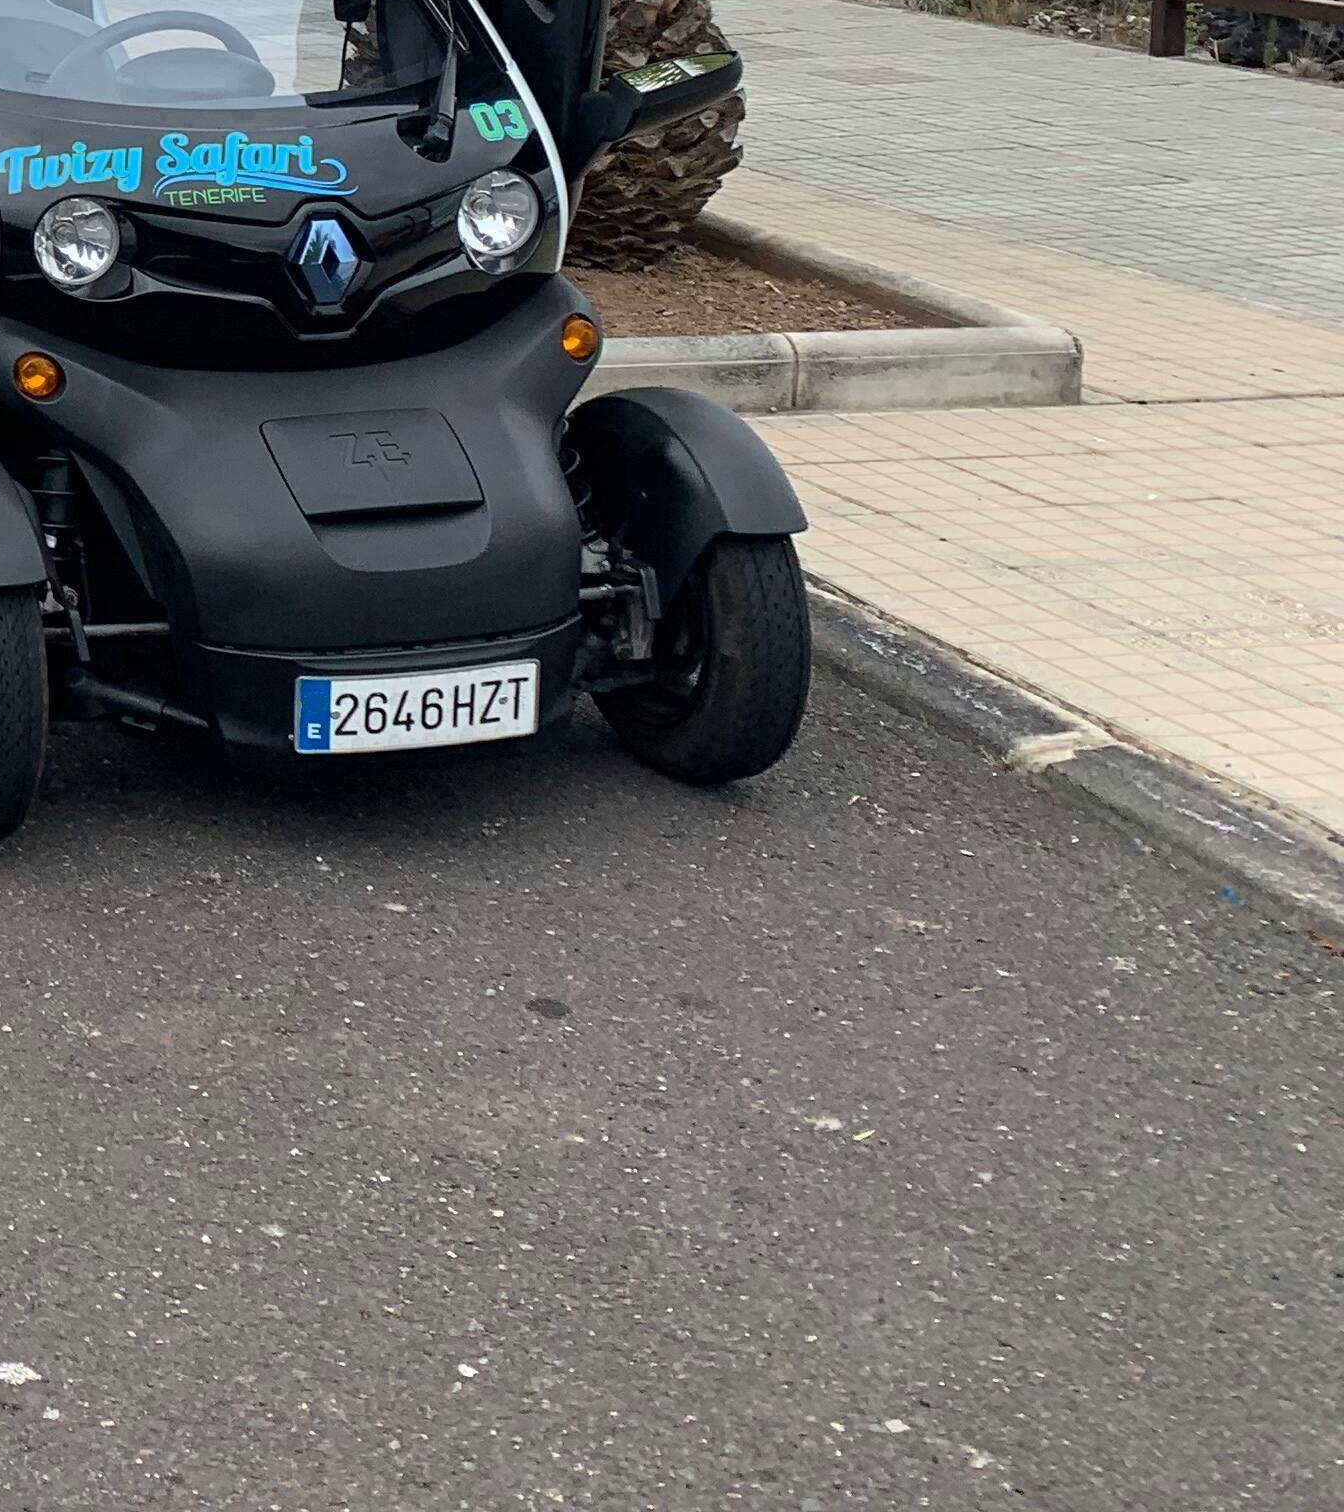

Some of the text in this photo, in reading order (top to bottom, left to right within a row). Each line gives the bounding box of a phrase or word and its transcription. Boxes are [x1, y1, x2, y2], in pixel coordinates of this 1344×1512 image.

[468, 99, 528, 142] 03
[155, 131, 318, 184] Safari
[164, 188, 267, 206] TENERIFE
[307, 723, 322, 739] E
